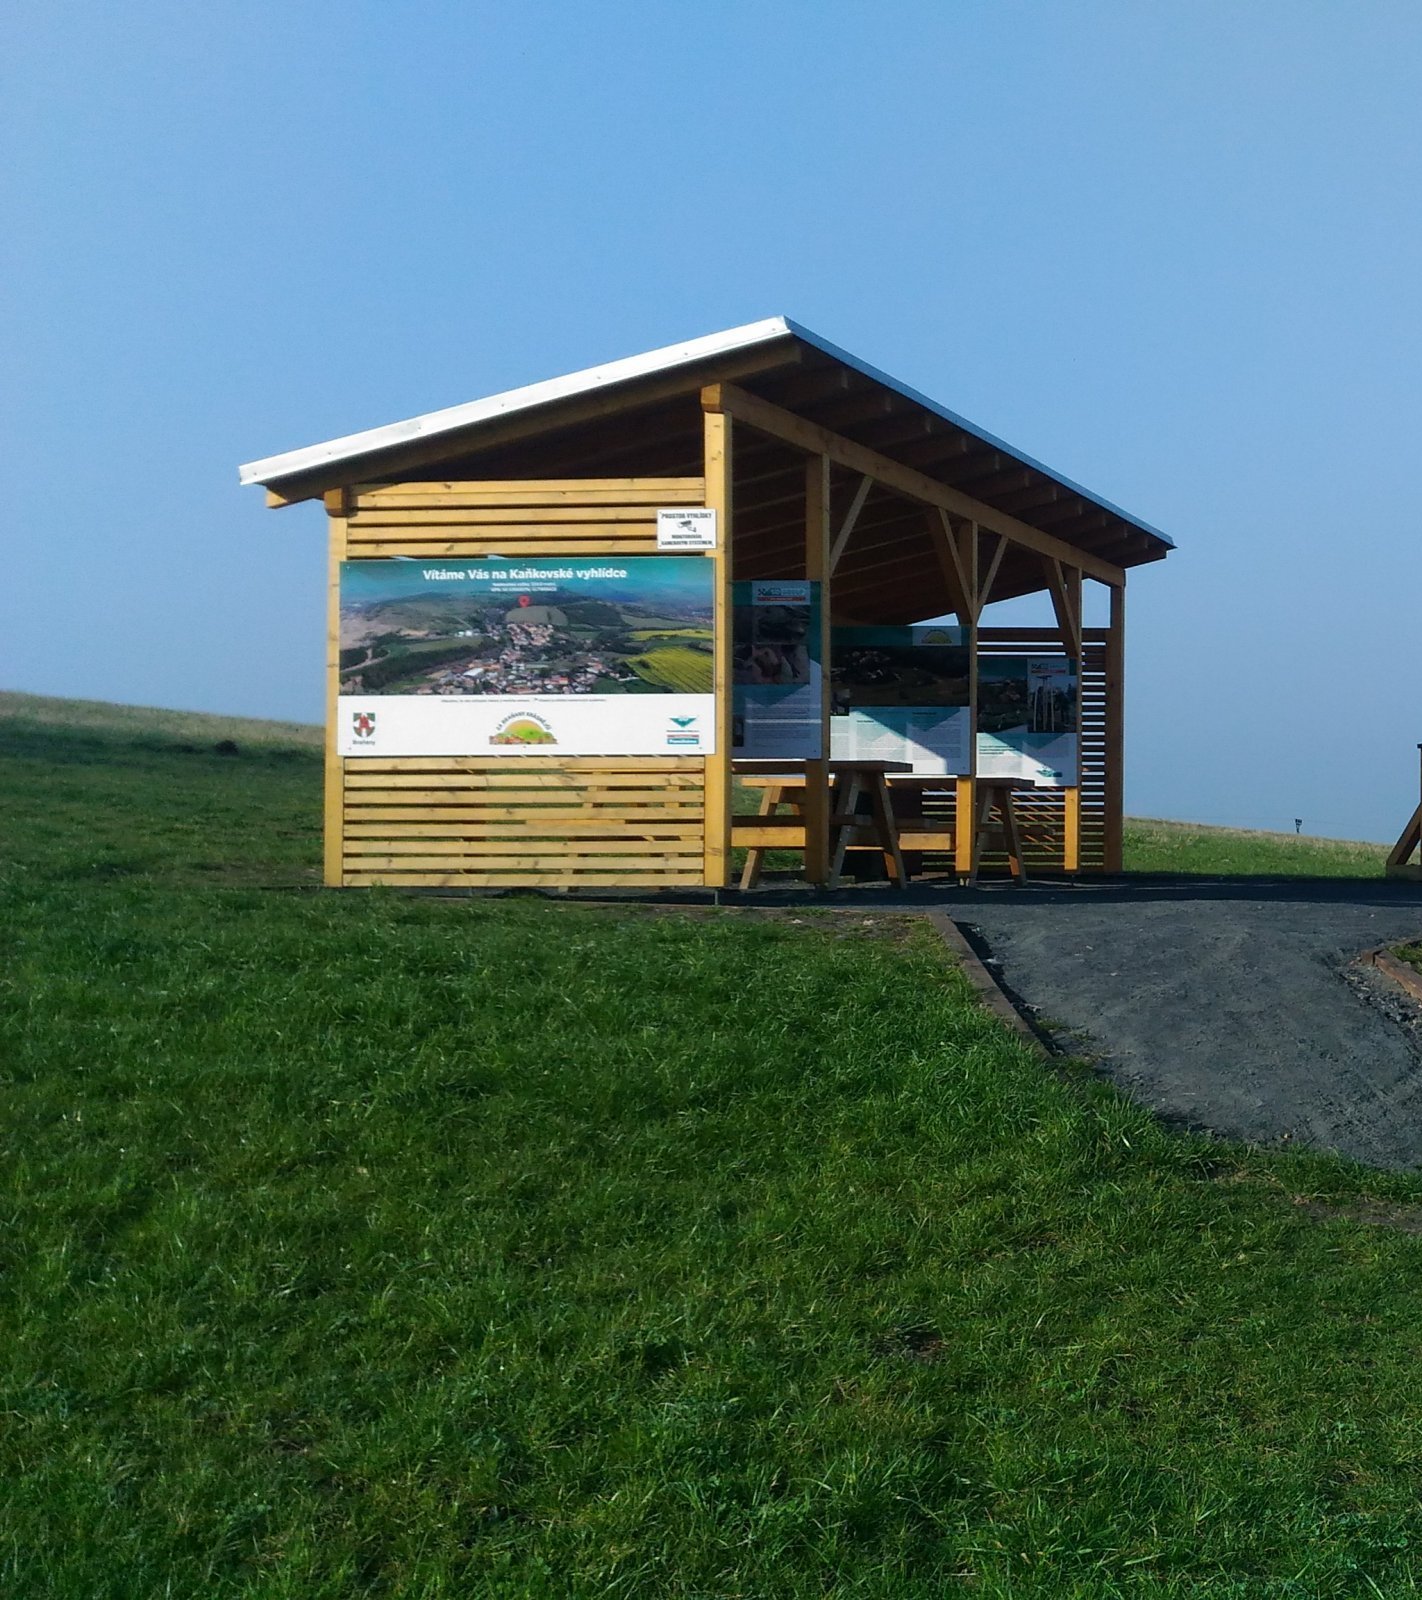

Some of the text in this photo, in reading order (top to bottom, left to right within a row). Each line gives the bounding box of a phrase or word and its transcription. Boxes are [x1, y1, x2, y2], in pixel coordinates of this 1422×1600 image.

[422, 567, 628, 580] Vítáme Vás na Kaňkovské vyhlídce
